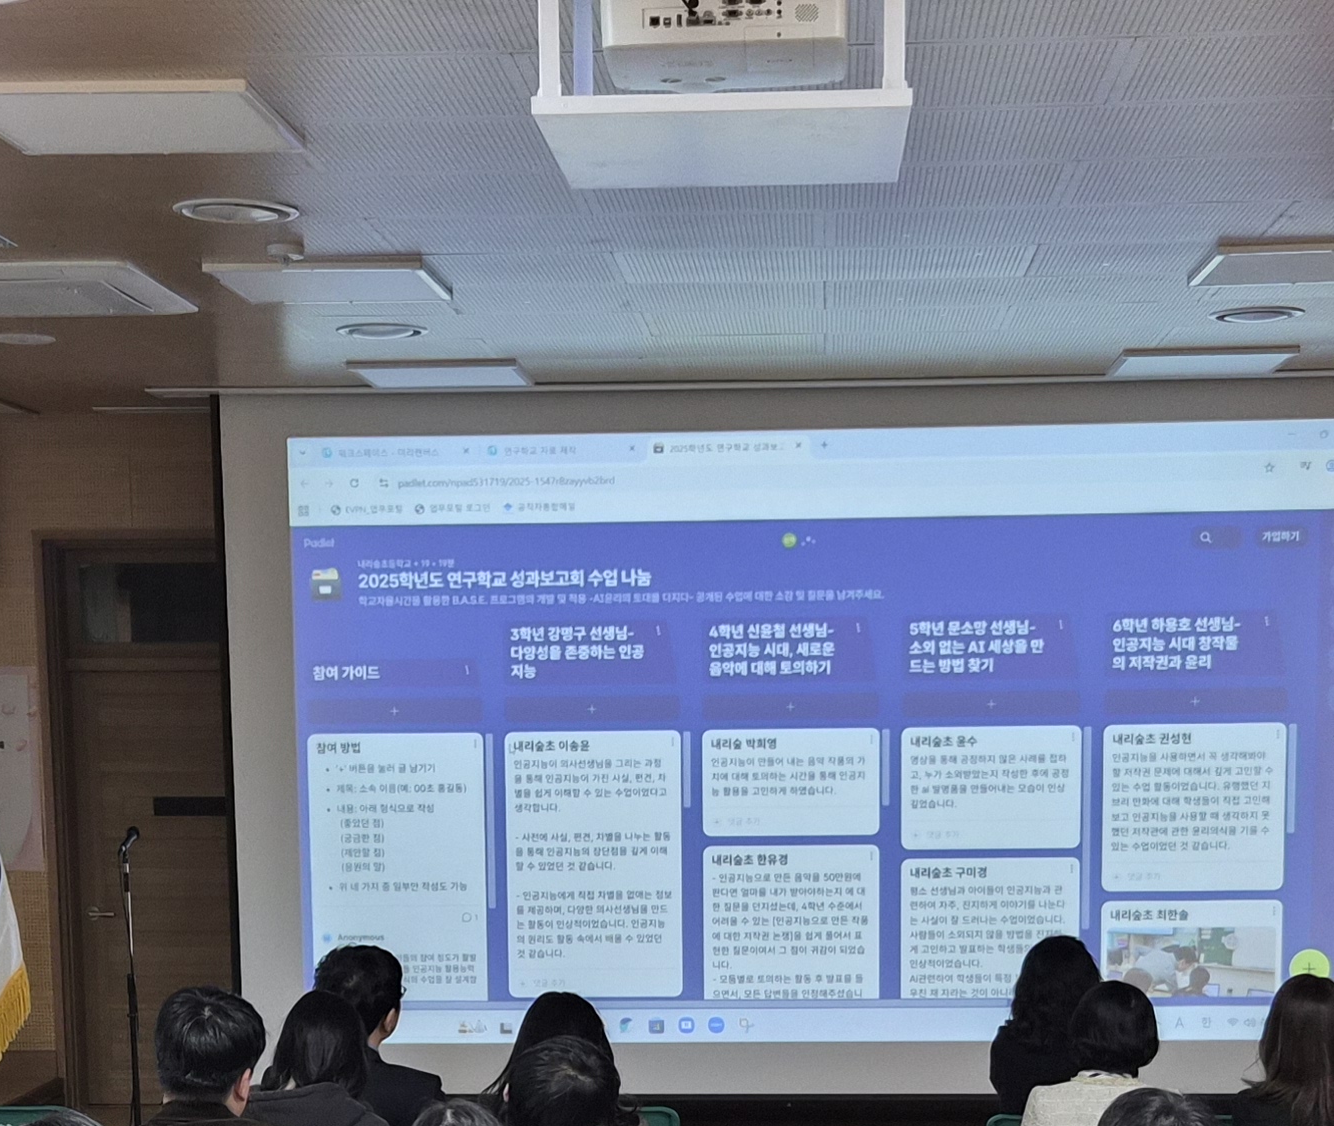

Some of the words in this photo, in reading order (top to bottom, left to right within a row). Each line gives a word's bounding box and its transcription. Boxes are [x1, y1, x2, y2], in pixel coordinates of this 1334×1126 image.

[1263, 530, 1299, 543] 가입하기
[358, 570, 444, 590] 2025학년도
[448, 569, 507, 589] 연구학교
[511, 568, 585, 589] 성과보고회
[588, 568, 619, 588] 수업
[622, 568, 652, 588] 나눔
[511, 626, 545, 642] 3학년
[548, 626, 586, 641] 강명구
[589, 625, 634, 641] 선생님-
[709, 623, 745, 640] 4학년
[747, 622, 785, 639] 신윤철
[789, 622, 834, 638] 선생님-
[909, 621, 944, 637] 5학년
[947, 620, 986, 636] 문소망
[990, 619, 1036, 636] 선생님-
[1112, 618, 1148, 634] 6학년
[1151, 617, 1192, 634] 하용호
[1194, 616, 1241, 633] 선생님-
[510, 645, 563, 661] 다양성을
[565, 644, 617, 661] 존중하는
[620, 644, 643, 660] 인공
[709, 643, 761, 659] 인공지능
[764, 642, 793, 660] 시대,
[796, 642, 835, 658] 새로운
[909, 640, 935, 656] 소외
[938, 640, 966, 655] 없는
[968, 640, 986, 655] AI
[988, 638, 1028, 655] 세상을
[1030, 638, 1044, 654] 만
[1112, 637, 1165, 653] 인공지능
[1168, 636, 1196, 653] 시대
[1198, 635, 1238, 652] 창작물
[511, 664, 535, 680] 지능
[709, 661, 748, 677] 음악에
[751, 660, 777, 677] 대해
[779, 660, 830, 676] 토의하기
[909, 658, 936, 675] 드는
[938, 657, 965, 674] 방법
[968, 656, 994, 674] 찾기
[1113, 656, 1125, 672] 의
[1128, 655, 1183, 672] 저작권과
[1185, 654, 1212, 671] 윤리
[313, 665, 337, 681] 참여
[341, 665, 379, 681] 가이드
[317, 741, 336, 755] 참여
[340, 741, 360, 755] 방법
[1109, 907, 1152, 922] 내리숲초
[1157, 907, 1188, 921] 최한솔
